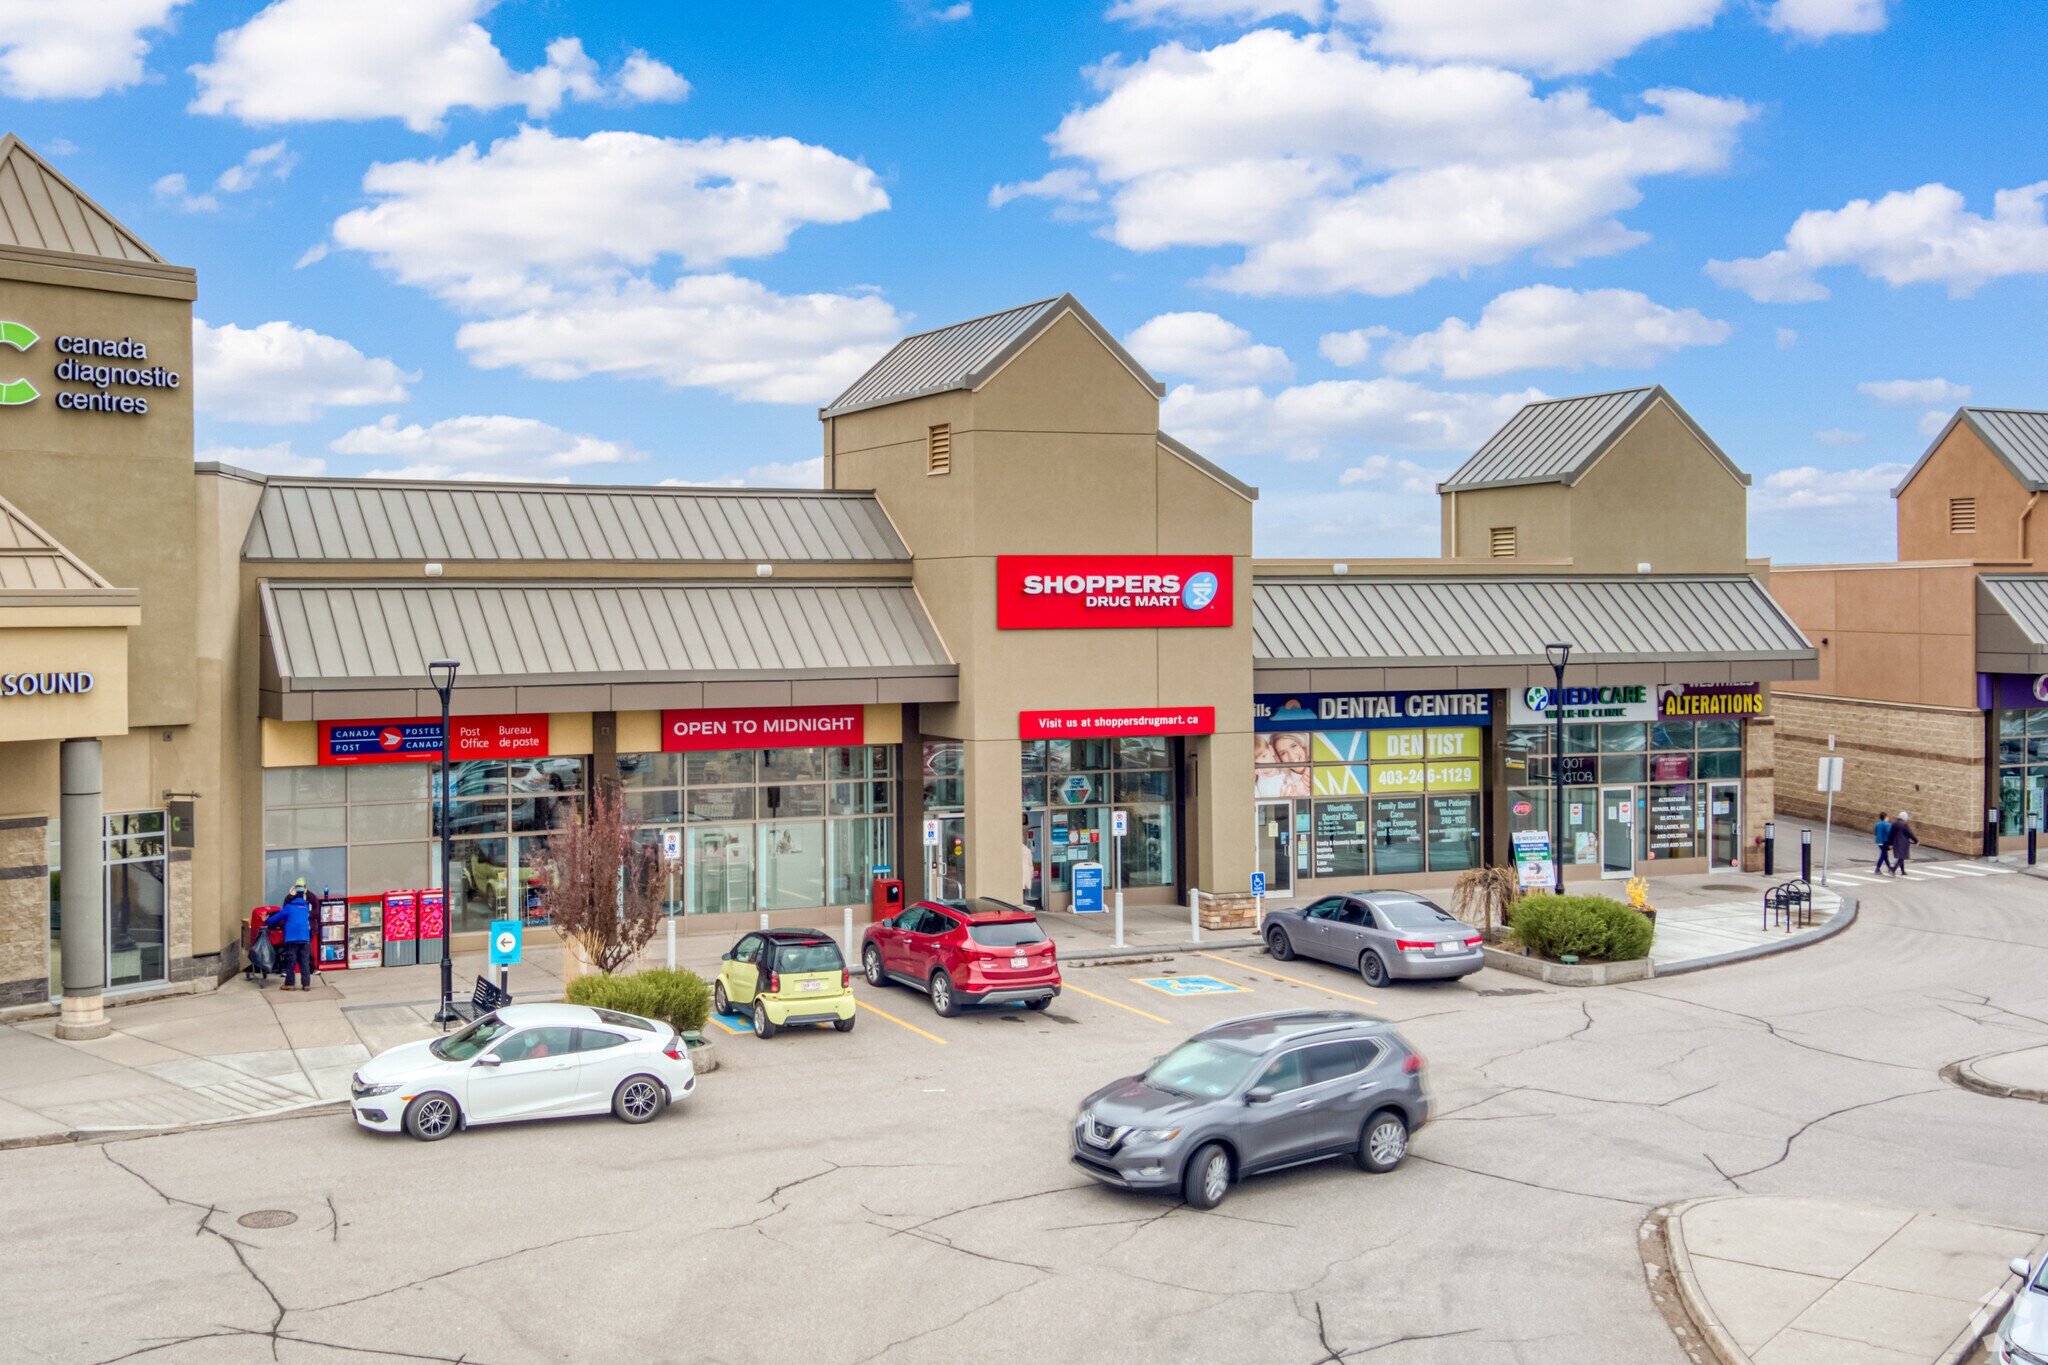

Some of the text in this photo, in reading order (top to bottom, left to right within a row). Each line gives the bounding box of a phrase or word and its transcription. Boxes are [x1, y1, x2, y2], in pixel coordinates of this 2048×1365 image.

[56, 335, 148, 360] canada
[55, 358, 180, 388] diagnostic
[56, 391, 149, 414] centres
[1023, 575, 1181, 594] SHOPPERS
[1086, 595, 1180, 607] DRUG MART
[0, 671, 95, 696] SOUND
[1549, 685, 1647, 706] MEDICARE
[1319, 696, 1402, 719] DENTAL
[1407, 693, 1489, 716] CENTRE
[1665, 693, 1763, 715] ALTERATIONS
[1545, 708, 1627, 719] WLK-IN CLINIC
[673, 717, 855, 736] OPEN TO MIDNIGHT
[1039, 718, 1062, 728] Visit
[1066, 719, 1078, 728] us
[1081, 718, 1091, 727] at
[335, 729, 376, 738] CANADA
[405, 727, 441, 736] POSTES
[460, 727, 480, 737] Post
[499, 725, 532, 735] Bureau
[335, 743, 361, 752] POST
[460, 738, 490, 749] Office
[499, 737, 540, 749] de poste
[1386, 732, 1465, 757] DENTIST
[1562, 757, 1585, 769] OOT
[1378, 767, 1472, 785] 403-246-1129
[1377, 800, 1416, 811] Family Dental
[1433, 798, 1472, 808] New Patients
[1321, 811, 1358, 822] Dental Clinic
[1389, 810, 1404, 819] Care
[1376, 818, 1417, 828] Open Evenings
